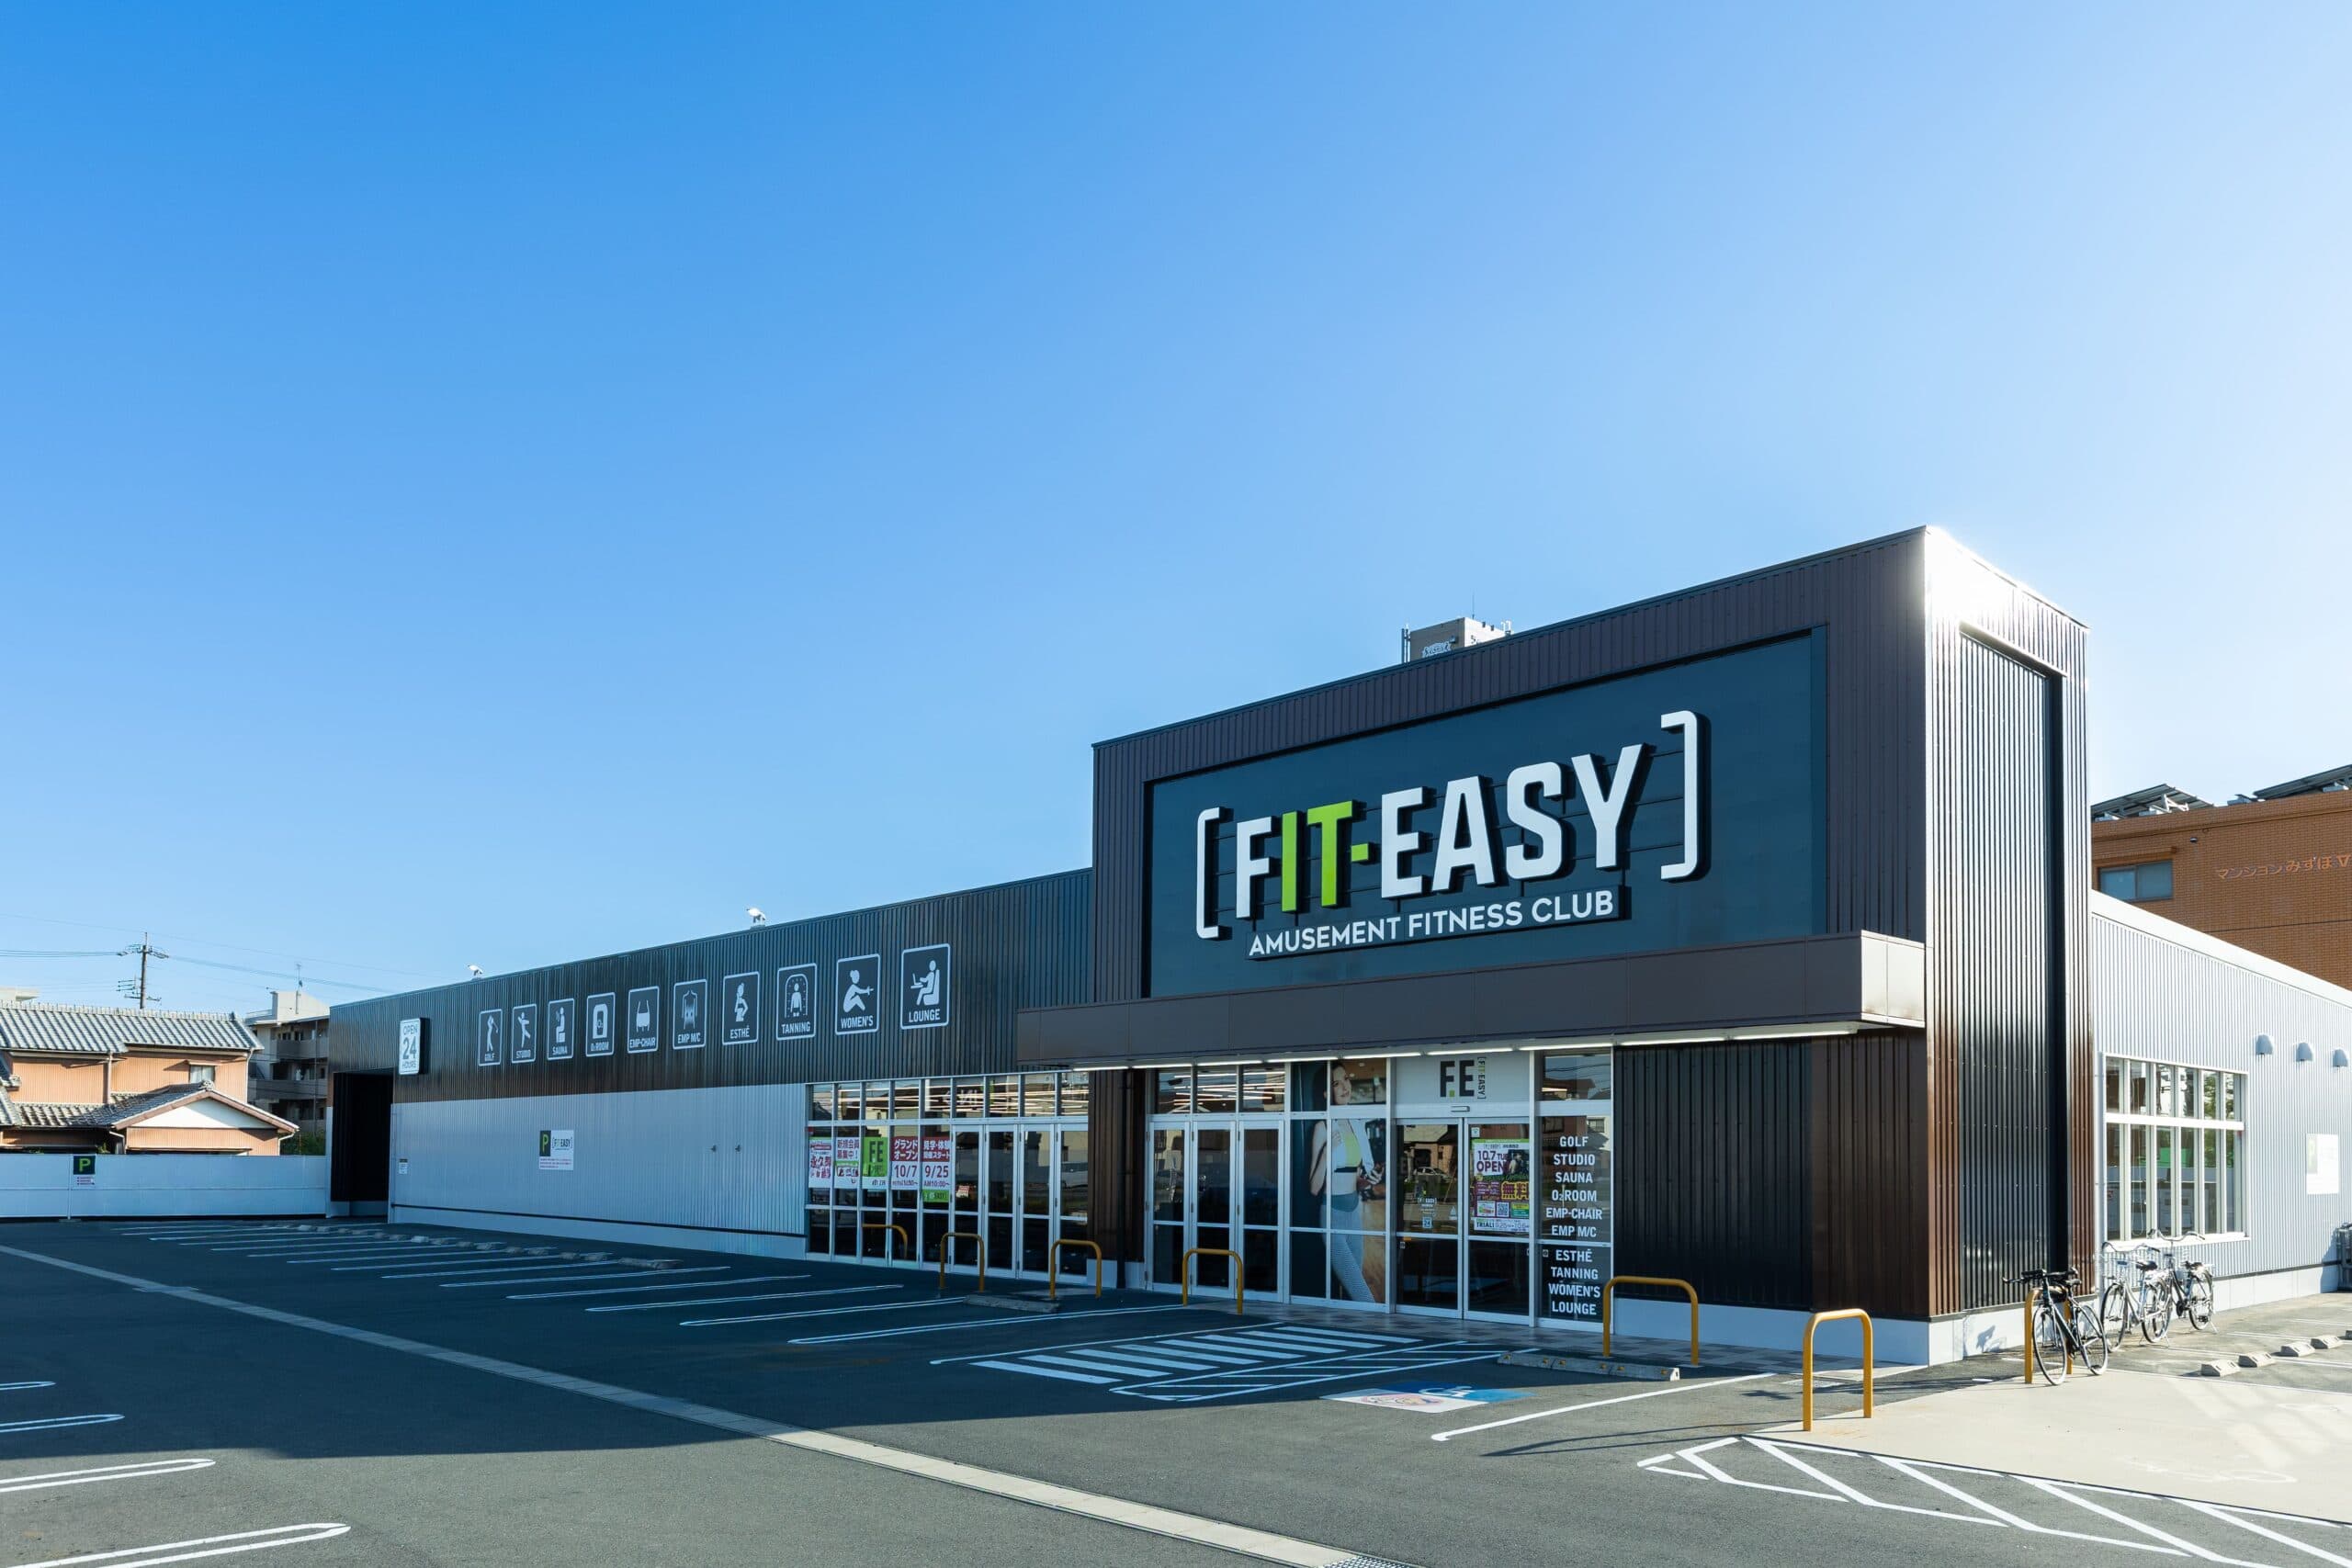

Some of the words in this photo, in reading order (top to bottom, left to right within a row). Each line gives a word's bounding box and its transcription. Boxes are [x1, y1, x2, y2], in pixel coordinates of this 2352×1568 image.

[1249, 916, 1402, 956] AMUSEMENT
[1408, 901, 1523, 938] FITNESS
[1532, 890, 1614, 923] CLUB
[841, 1016, 874, 1029] WOMEN'S
[909, 1009, 941, 1023] LOUNGE
[781, 1021, 810, 1034] TANNING
[677, 1033, 689, 1044] EMP
[402, 1036, 417, 1059] 24
[552, 1045, 568, 1055] SAUNA
[542, 1134, 549, 1153] P
[894, 1140, 918, 1150] グランド
[1559, 1136, 1589, 1147] GOLF
[894, 1150, 918, 1160] オープン
[1553, 1154, 1596, 1166] STUDIO
[79, 1158, 91, 1172] P
[894, 1165, 918, 1178] 10/7
[924, 1165, 949, 1179] 9/25
[1555, 1171, 1593, 1184] SAUNA
[1545, 1207, 1602, 1221] EMP-CHAIR
[1551, 1224, 1576, 1236] EMP
[1577, 1226, 1597, 1238] M/C
[1550, 1266, 1599, 1280] TANNING
[1548, 1283, 1601, 1298] WOMEN'S
[1551, 1301, 1597, 1315] LOUNGE
